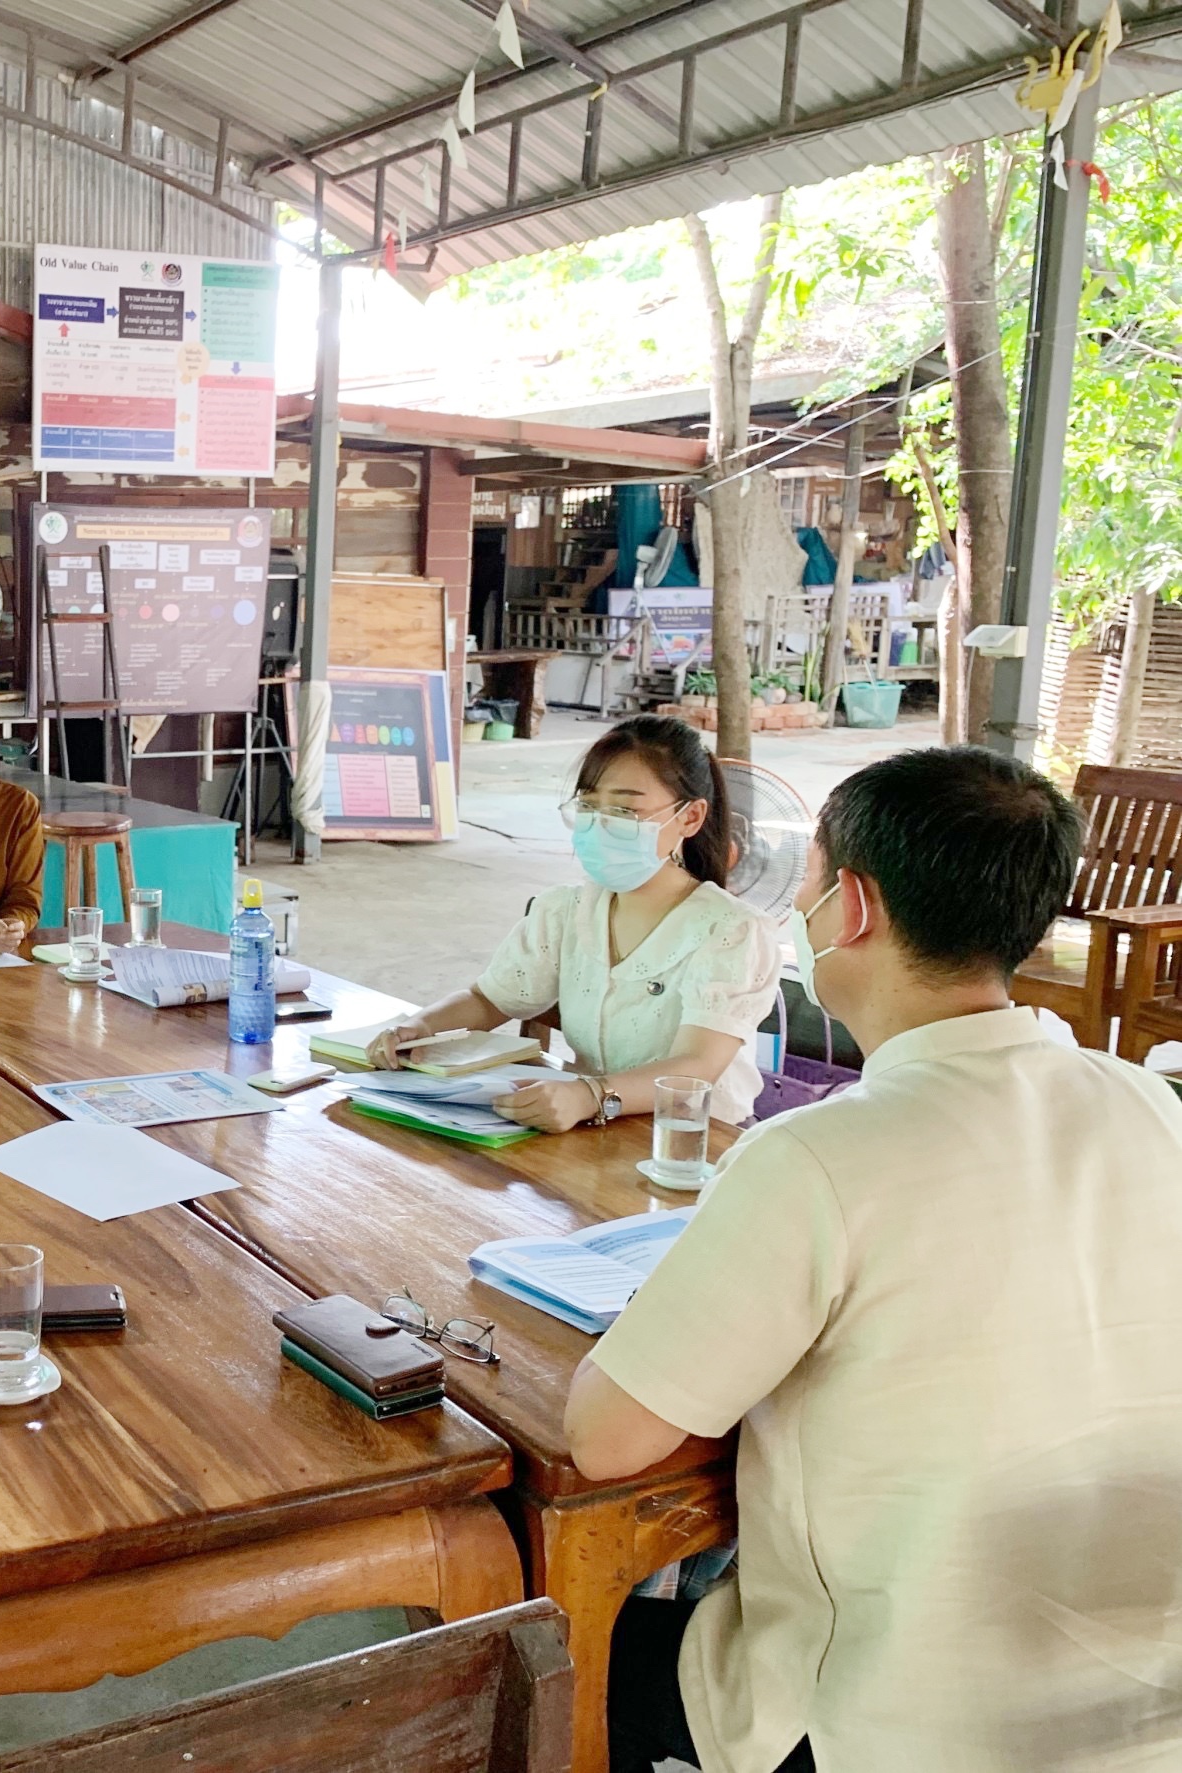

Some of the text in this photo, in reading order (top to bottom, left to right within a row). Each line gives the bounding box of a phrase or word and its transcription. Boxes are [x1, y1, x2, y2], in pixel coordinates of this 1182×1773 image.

[40, 257, 119, 272] Old Value Chain
